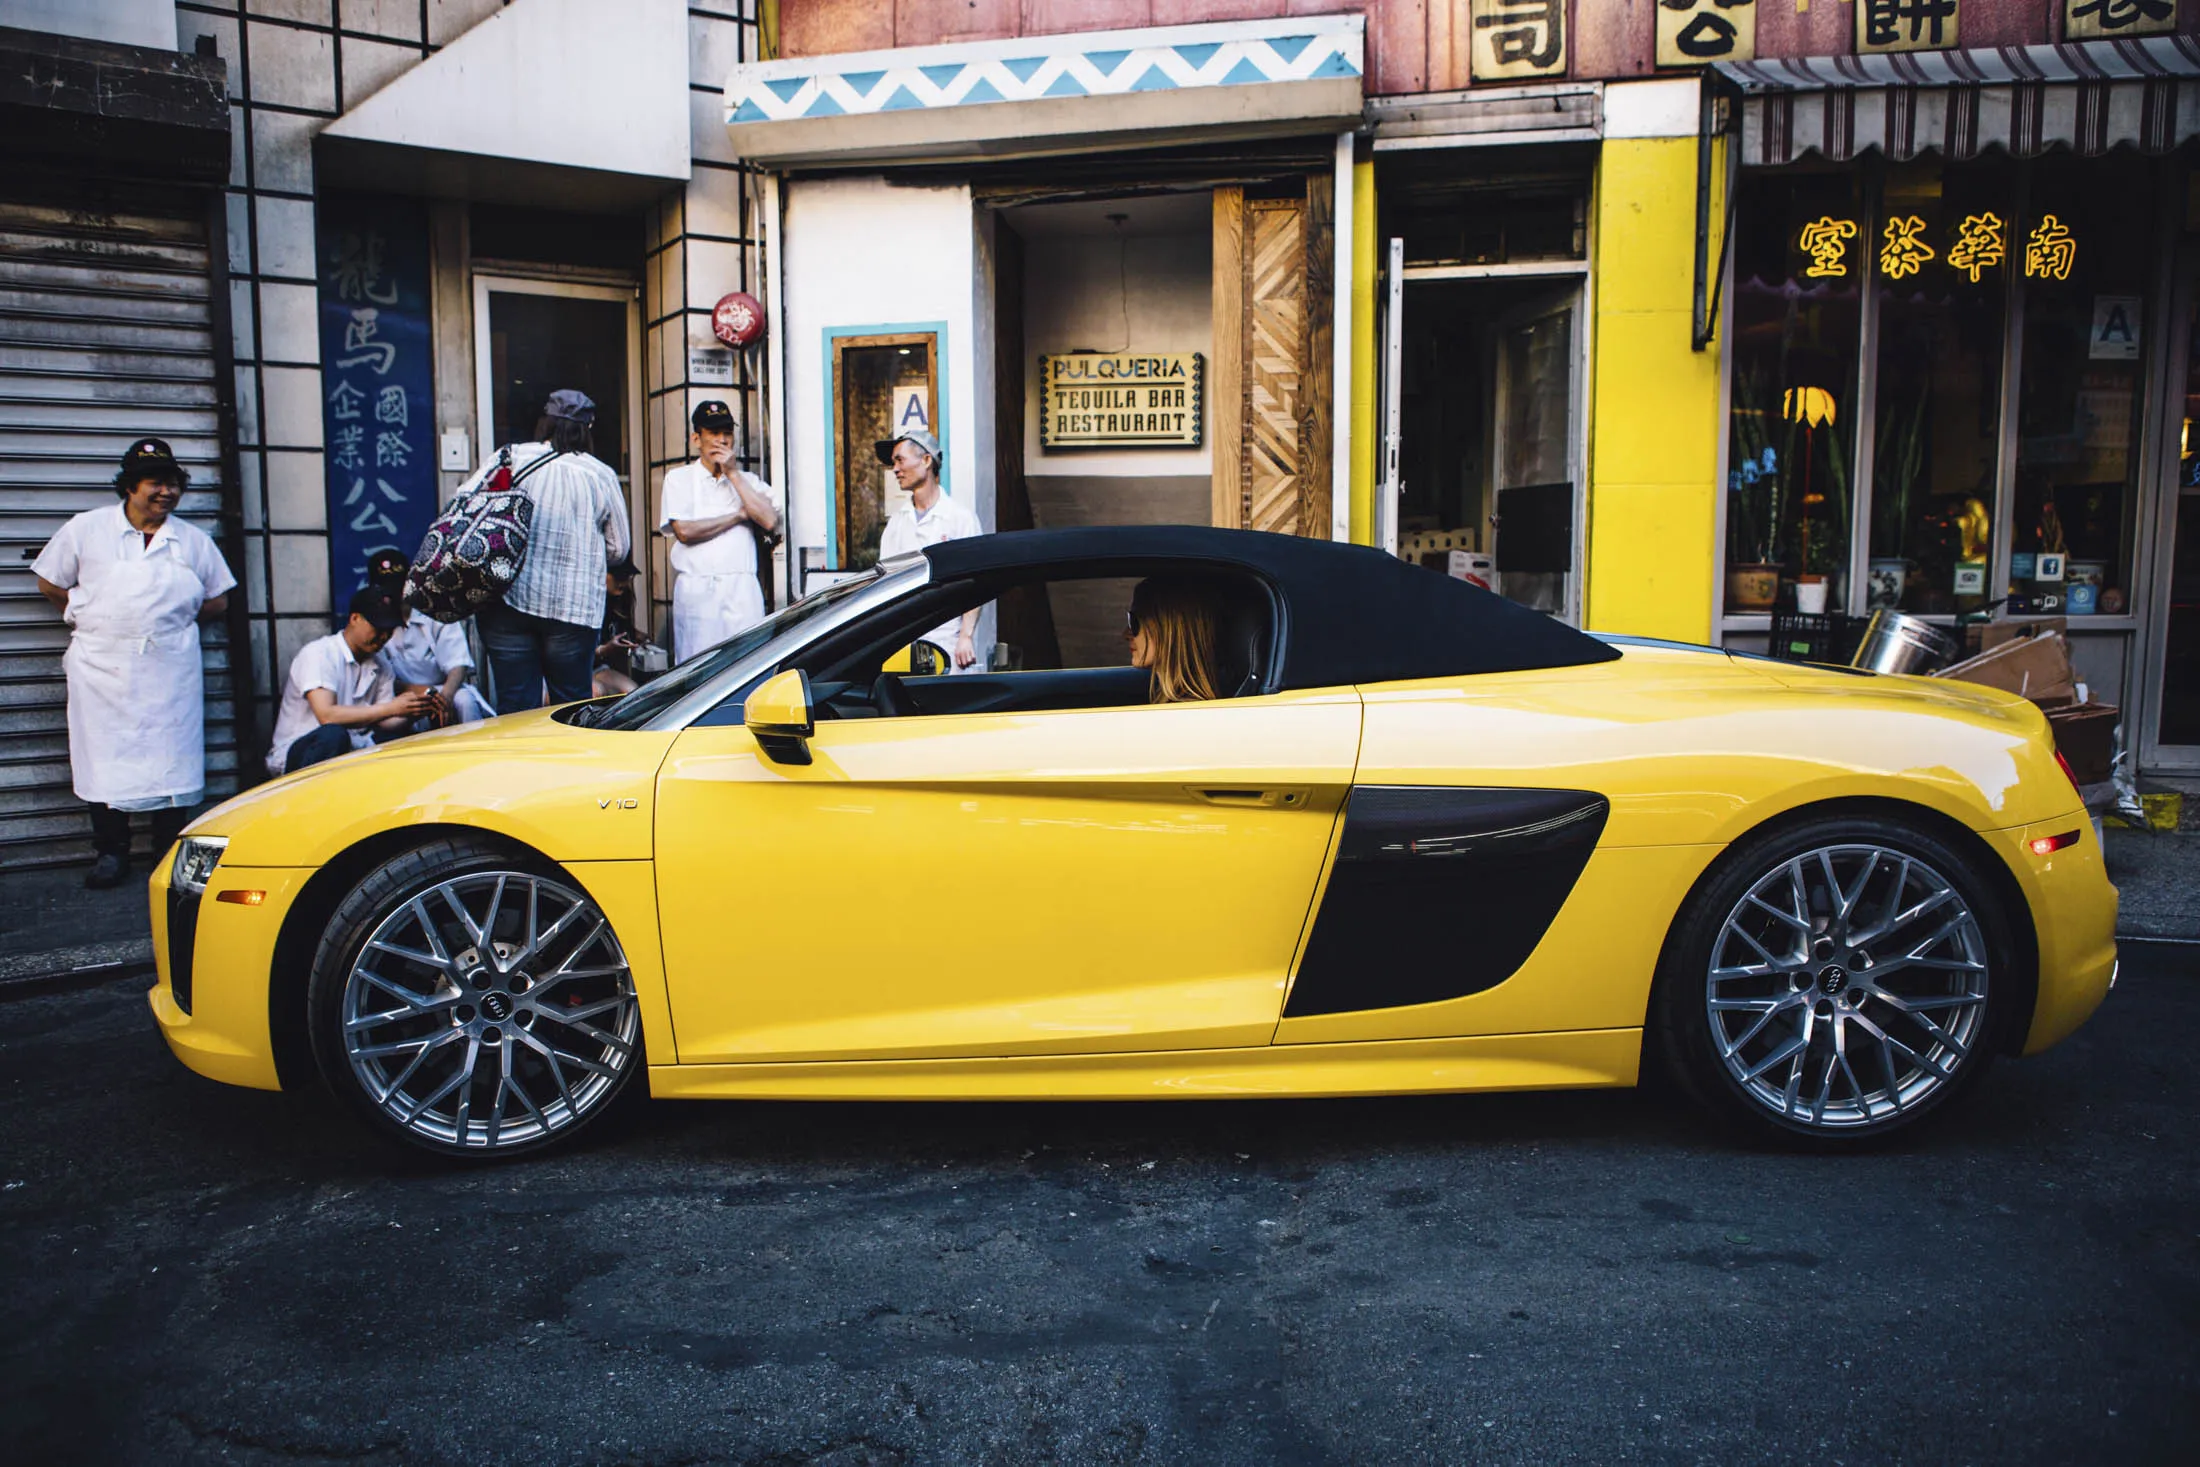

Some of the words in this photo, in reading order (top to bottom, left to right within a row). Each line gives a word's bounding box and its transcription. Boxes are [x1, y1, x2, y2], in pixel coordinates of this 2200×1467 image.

[2098, 303, 2133, 342] A
[1054, 358, 1186, 379] PULQUERIA
[901, 393, 928, 426] A
[1056, 390, 1136, 410] TEQUILA
[1148, 389, 1185, 408] BAR
[1057, 413, 1185, 433] RESTAURANT
